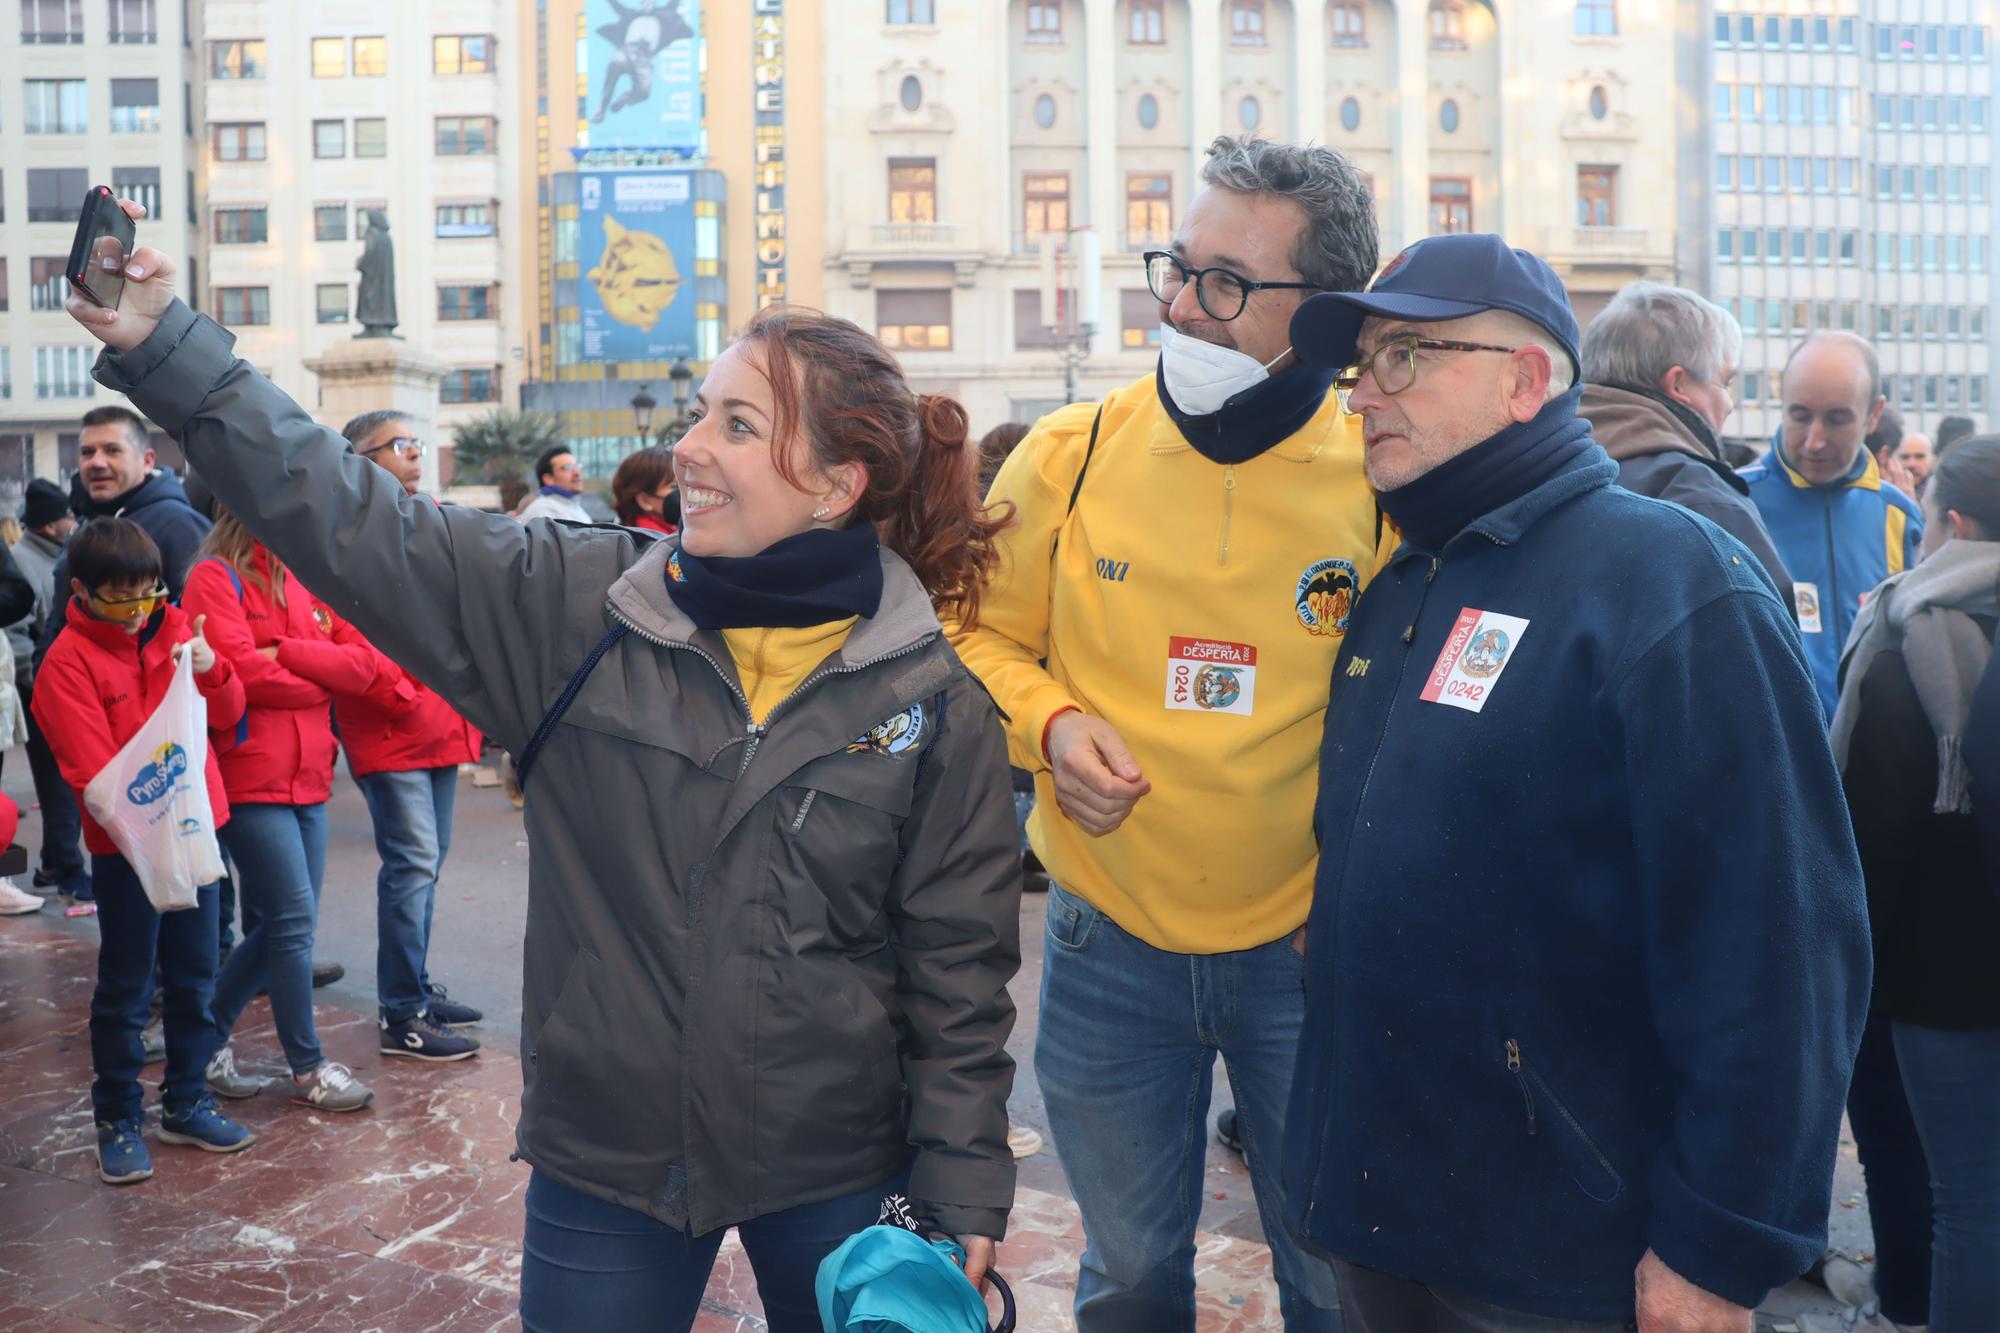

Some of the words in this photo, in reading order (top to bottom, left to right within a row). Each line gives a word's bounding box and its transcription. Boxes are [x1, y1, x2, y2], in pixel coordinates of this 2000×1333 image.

[1182, 646, 1242, 661] DESPERTÀ
[1174, 665, 1190, 703] 0243
[1447, 680, 1484, 701] 0242
